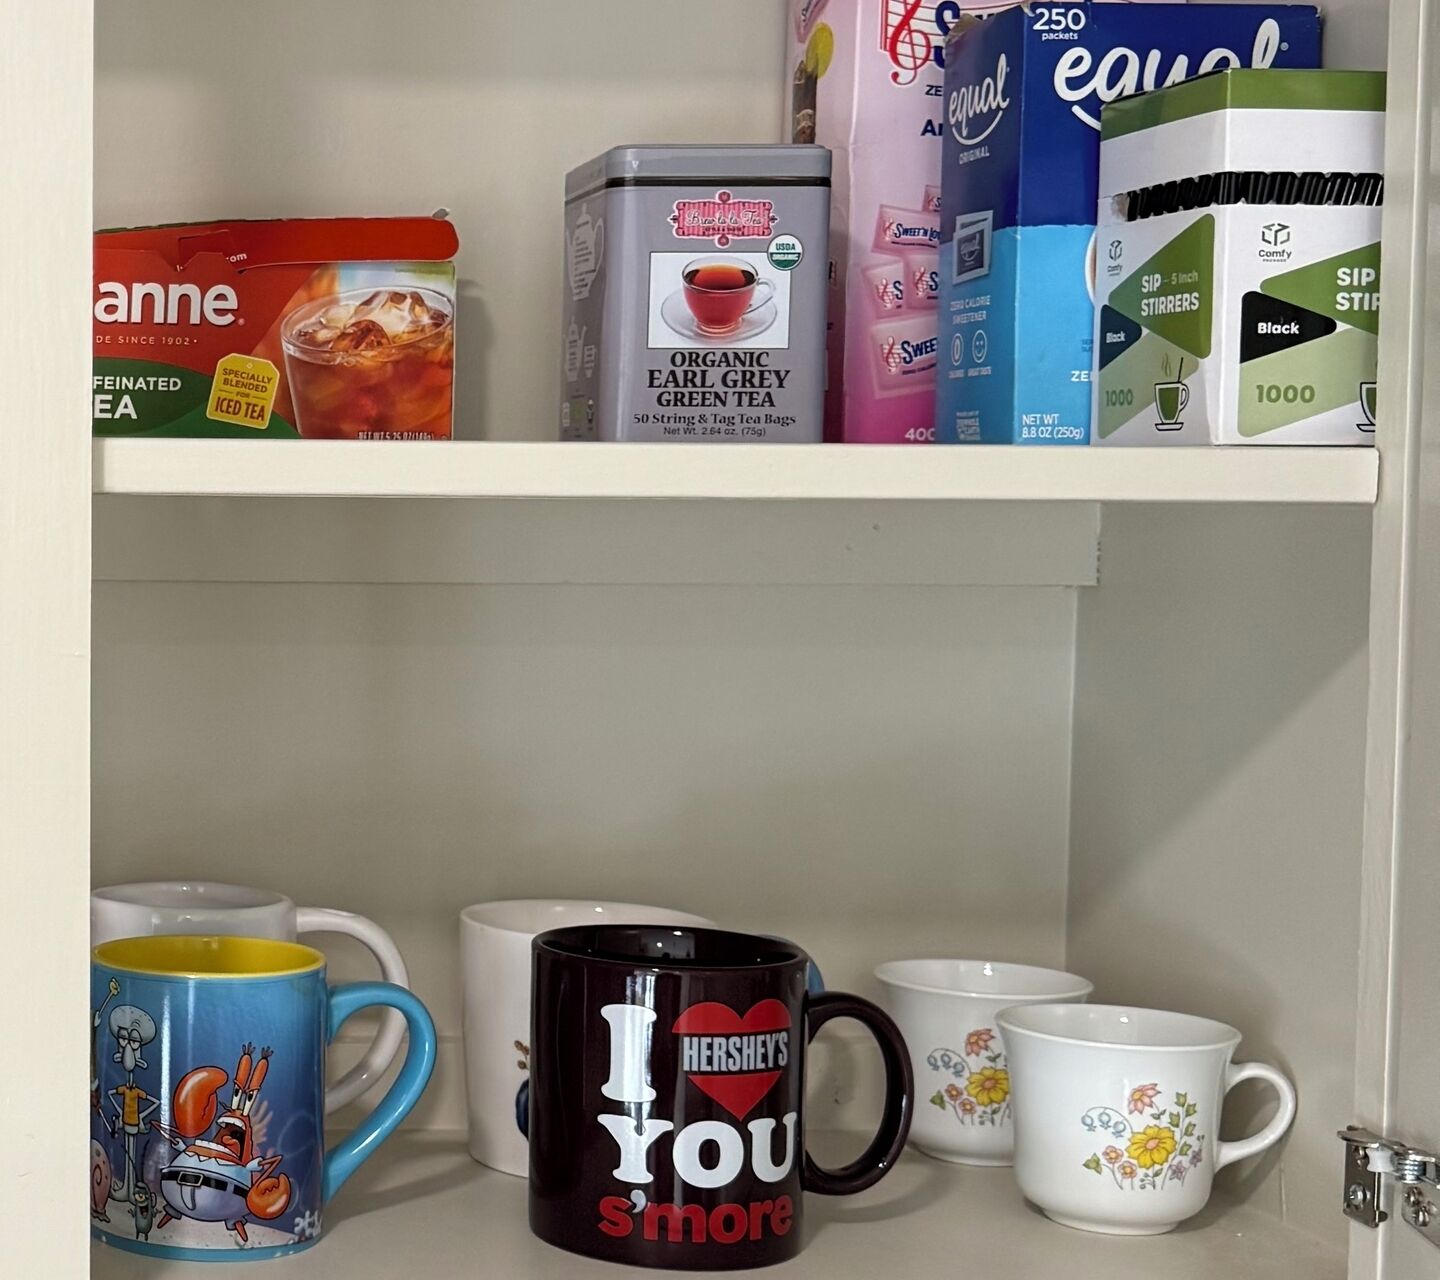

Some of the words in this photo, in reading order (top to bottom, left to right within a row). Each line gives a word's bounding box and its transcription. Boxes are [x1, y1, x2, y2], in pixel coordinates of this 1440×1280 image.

[1033, 8, 1086, 31] 250
[1042, 32, 1078, 41] packets
[949, 53, 1010, 137] equal
[959, 145, 990, 165] ORIGINAL
[776, 243, 796, 251] USDA
[1258, 249, 1292, 260] Comfy
[1141, 274, 1162, 293] SIP
[1171, 273, 1178, 284] 5
[1178, 270, 1198, 284] Inch
[1336, 268, 1376, 287] SIP
[965, 296, 991, 309] CALORIE
[1141, 292, 1200, 316] STIRRERS
[1257, 322, 1300, 334] Black
[118, 336, 155, 344] SINCE
[162, 337, 190, 345] 1902
[1106, 332, 1126, 343] Black
[670, 351, 769, 368] ORGANIC
[222, 367, 273, 384] SPECIALLY
[647, 369, 715, 388] EARL
[721, 369, 790, 388] GREY
[222, 377, 268, 393] BLENDED
[1256, 384, 1315, 403] 1000
[235, 391, 251, 399] FOR
[656, 391, 728, 407] GREEN
[732, 391, 776, 407] TEA
[1106, 389, 1134, 407] 1000
[215, 396, 242, 416] ICED
[244, 402, 266, 421] TEA
[633, 414, 649, 424] 50
[652, 413, 695, 426] String
[698, 414, 708, 424] &
[710, 413, 736, 427] Tag
[737, 413, 761, 424] Tea
[764, 413, 796, 427] Bags
[1022, 415, 1042, 425] NET
[1044, 414, 1059, 424] WT
[663, 427, 681, 435] Net
[683, 427, 698, 435] Wt.
[701, 427, 722, 436] 2.64
[724, 428, 738, 436] oz.
[741, 427, 766, 438] (75g)
[1022, 427, 1037, 437] 8.8
[1038, 427, 1052, 437] OZ
[1054, 426, 1085, 439] (250g)
[600, 1004, 657, 1102] I
[682, 1030, 789, 1072] HERSHEY'S
[597, 1111, 797, 1189] YOU
[597, 1189, 793, 1244] s'more
